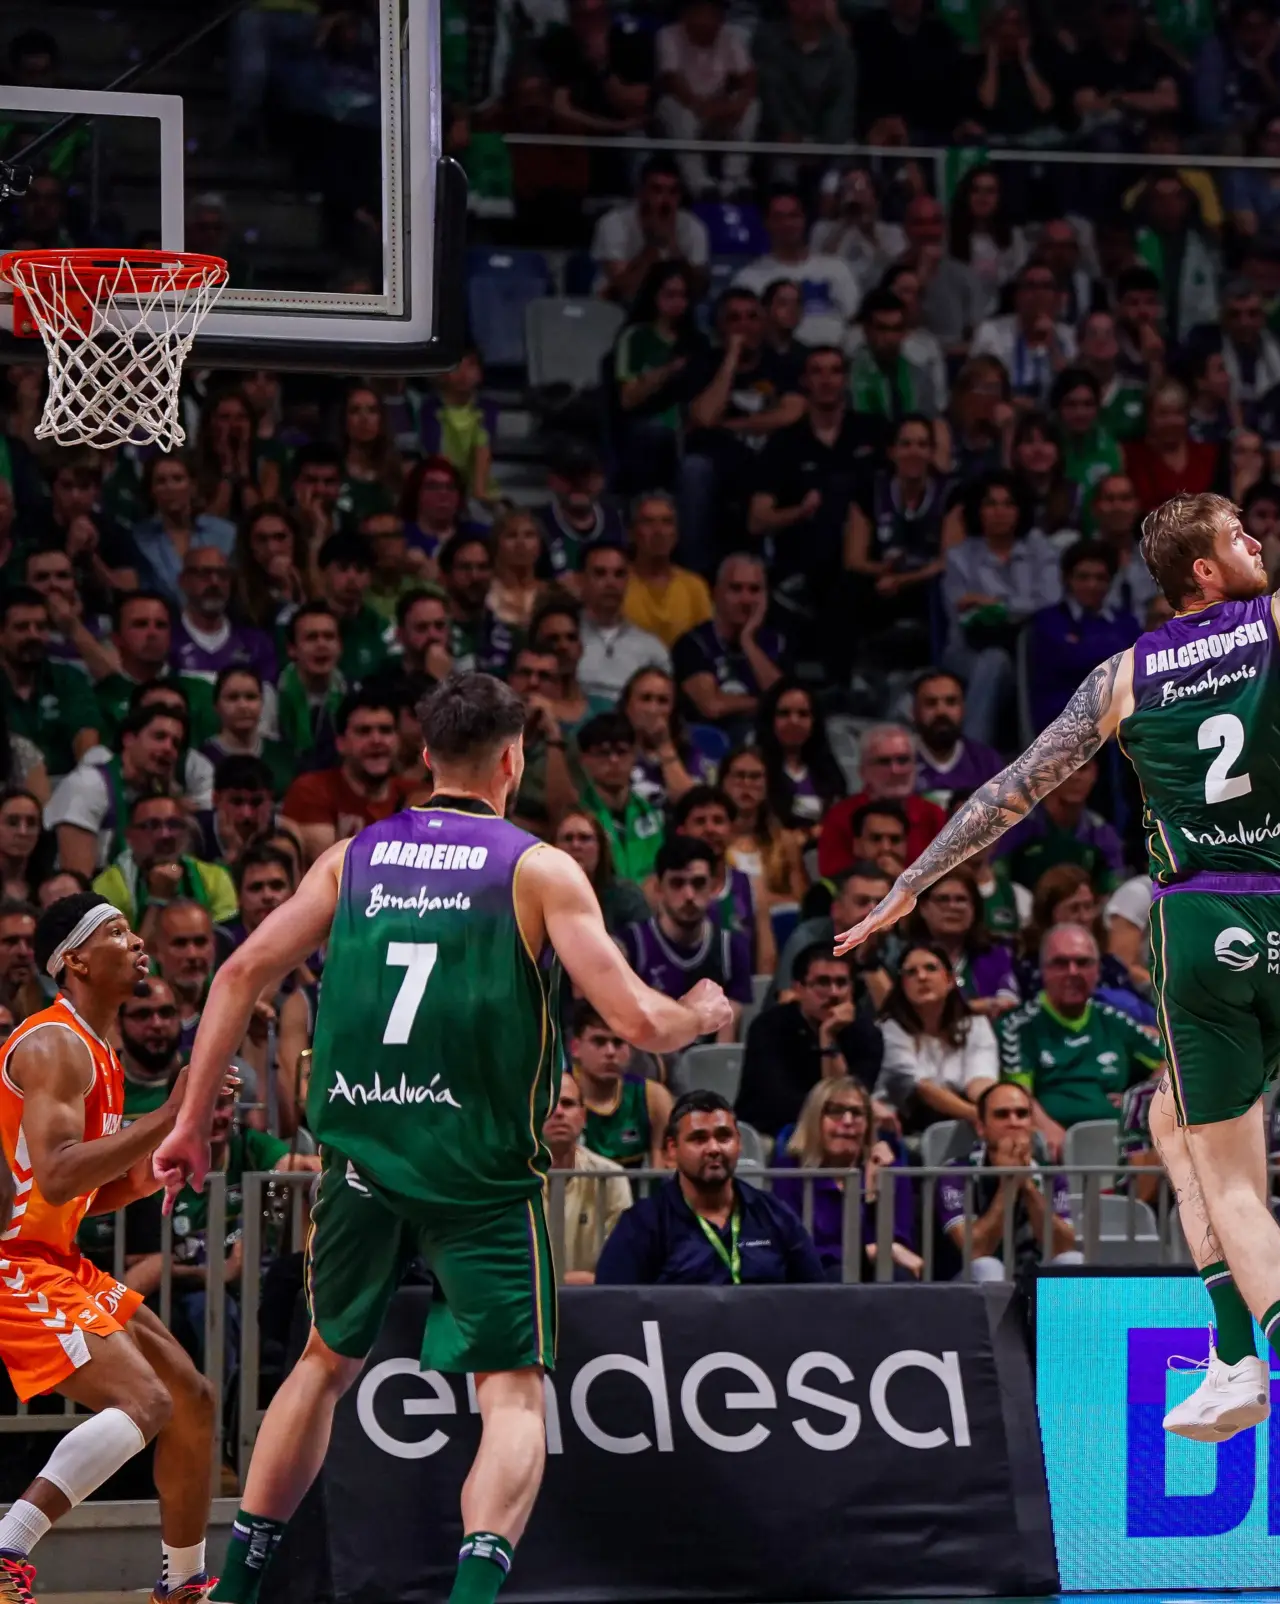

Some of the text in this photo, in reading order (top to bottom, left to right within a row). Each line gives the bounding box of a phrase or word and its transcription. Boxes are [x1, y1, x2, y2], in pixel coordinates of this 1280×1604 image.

[1146, 620, 1268, 676] BALCEROWSKI
[1197, 713, 1252, 805] 2
[370, 840, 488, 870] BARREIRO
[382, 941, 438, 1045] 7
[327, 1070, 462, 1108] Andalucía
